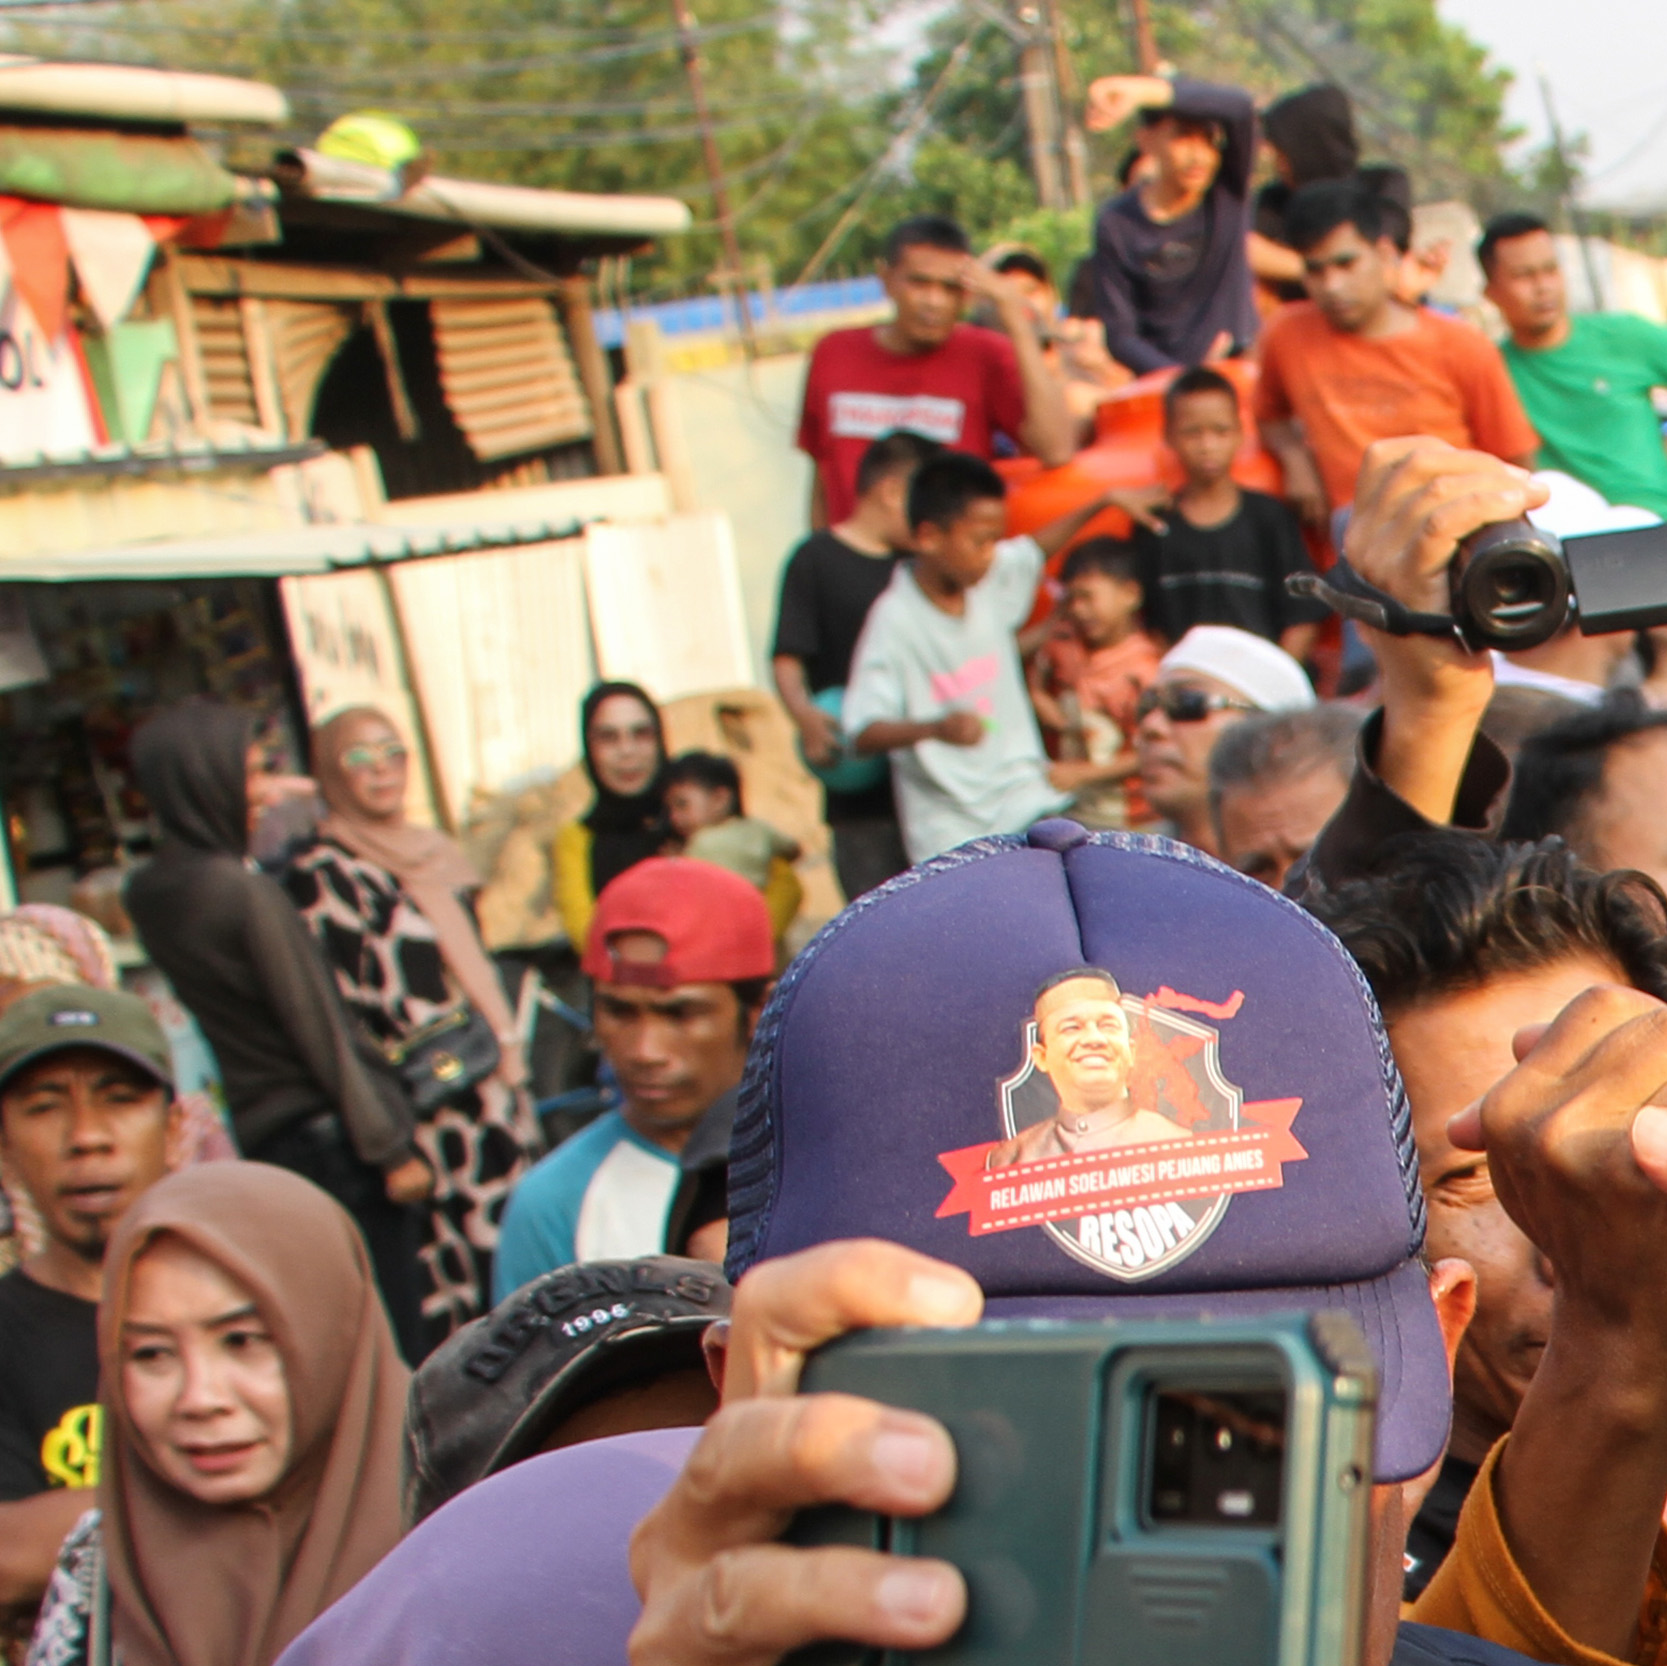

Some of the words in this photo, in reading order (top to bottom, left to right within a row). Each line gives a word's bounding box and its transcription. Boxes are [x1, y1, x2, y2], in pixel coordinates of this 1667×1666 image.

[990, 1178, 1066, 1211] RELAWAN
[1069, 1163, 1156, 1195] SOELAWESI
[1158, 1152, 1221, 1181] PEJUANG
[1223, 1148, 1264, 1173] ANIES
[1078, 1201, 1197, 1268] RESOPA
